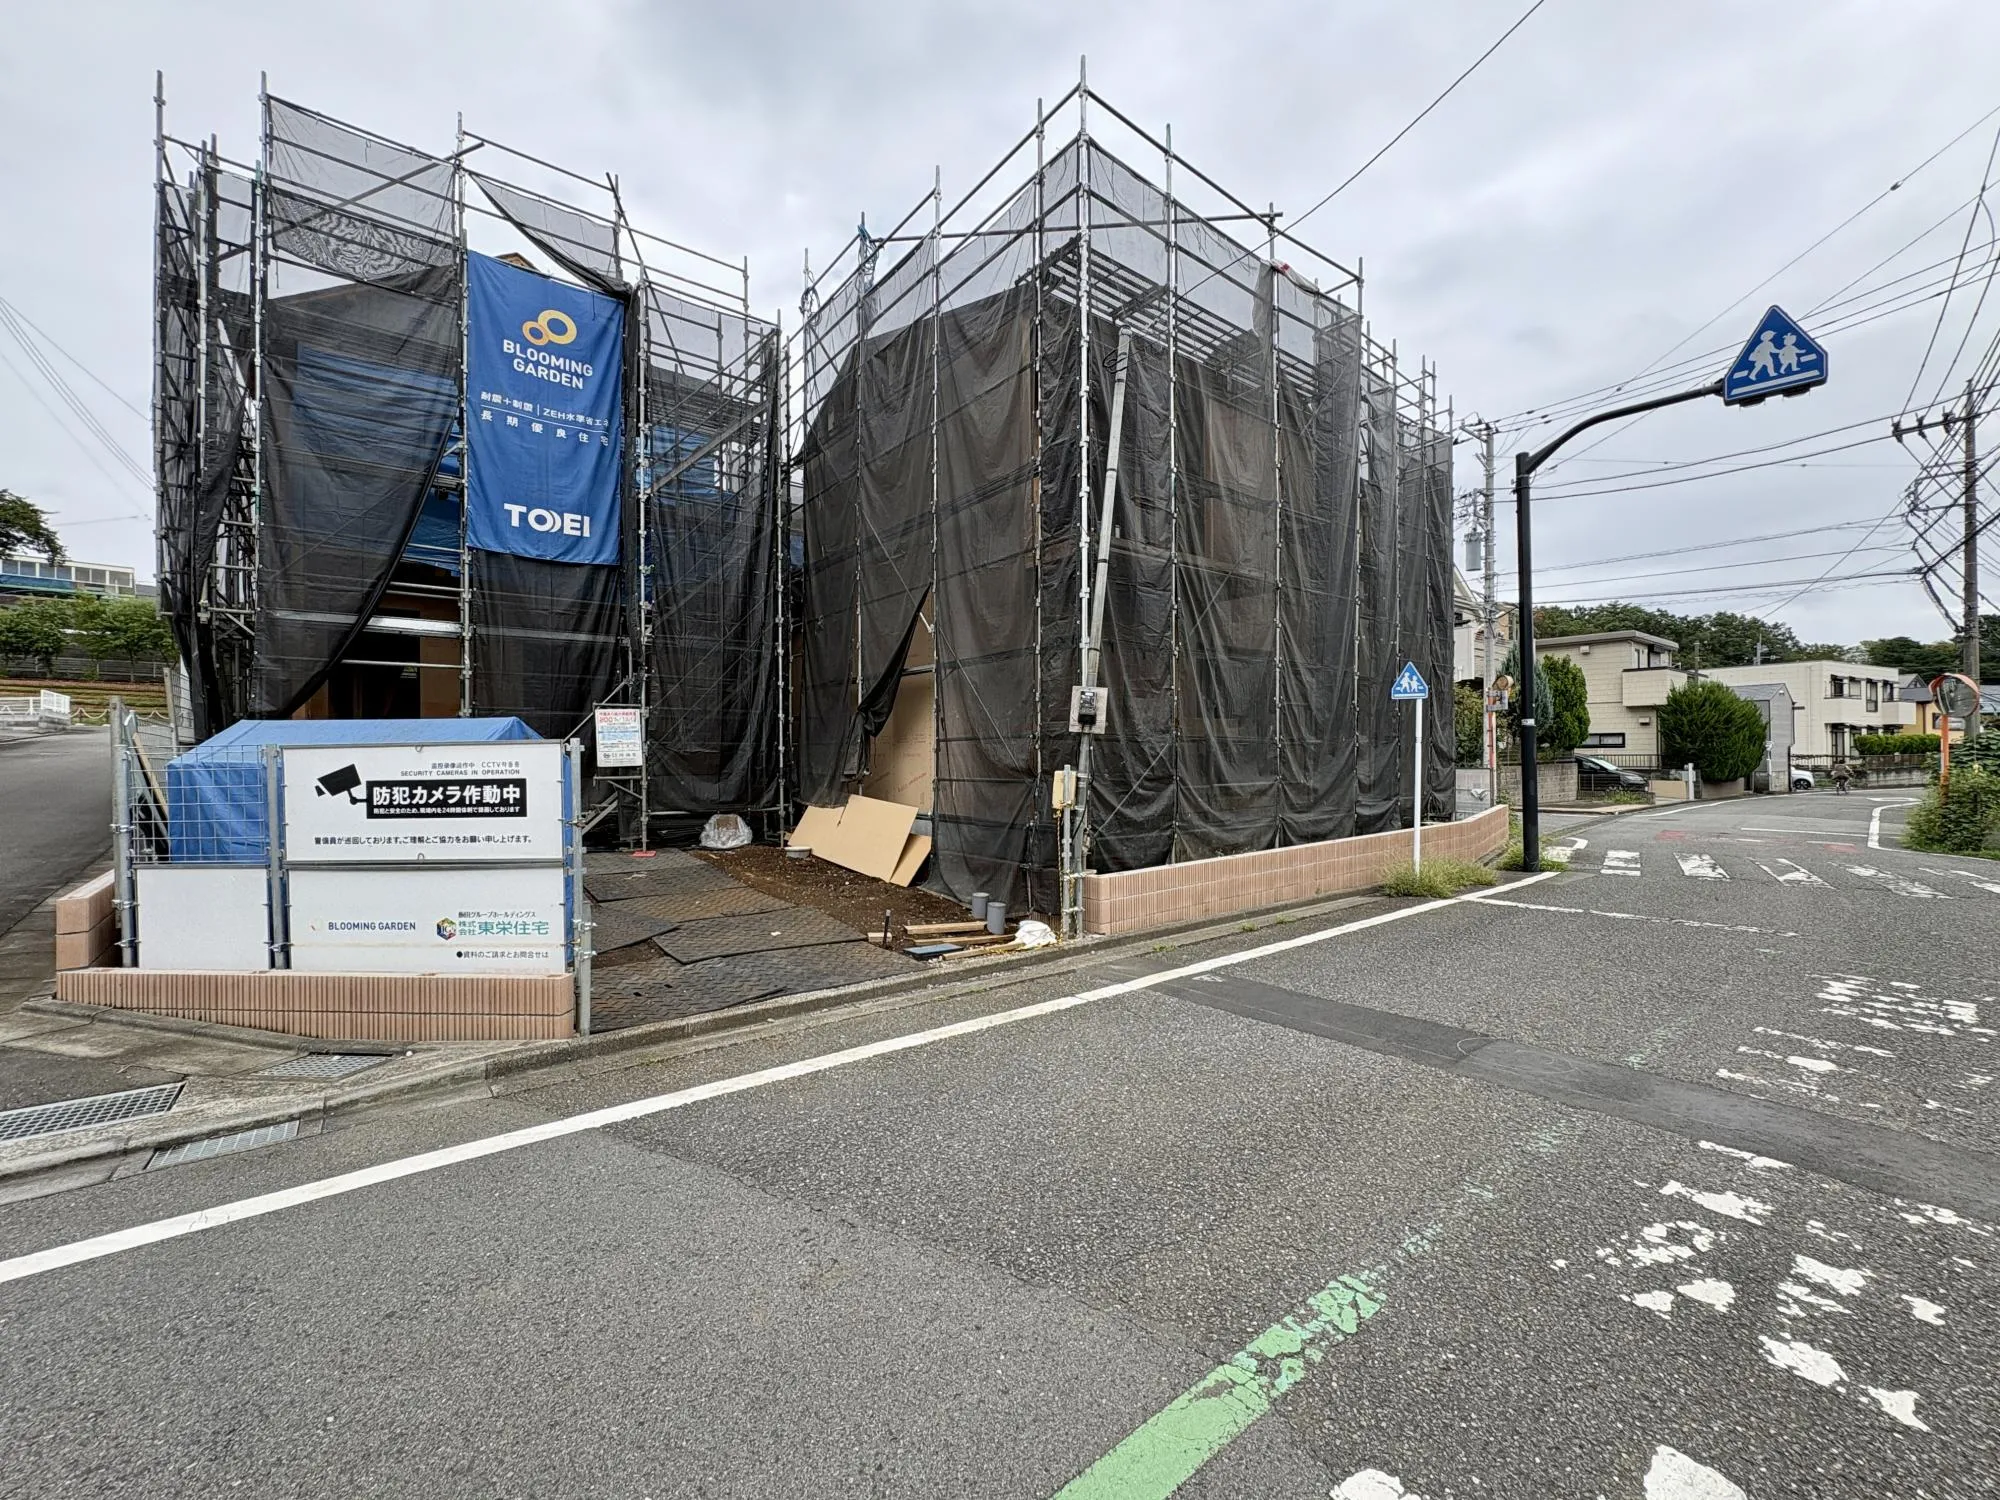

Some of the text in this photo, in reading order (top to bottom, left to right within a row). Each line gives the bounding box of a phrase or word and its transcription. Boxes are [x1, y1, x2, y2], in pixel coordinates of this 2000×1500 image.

[503, 339, 593, 377] BLOOMING
[513, 358, 584, 390] GARDEN
[503, 502, 591, 538] TOEI
[372, 784, 521, 806] 防犯カメラ作動中
[328, 921, 416, 930] BLOOMING GARDEN
